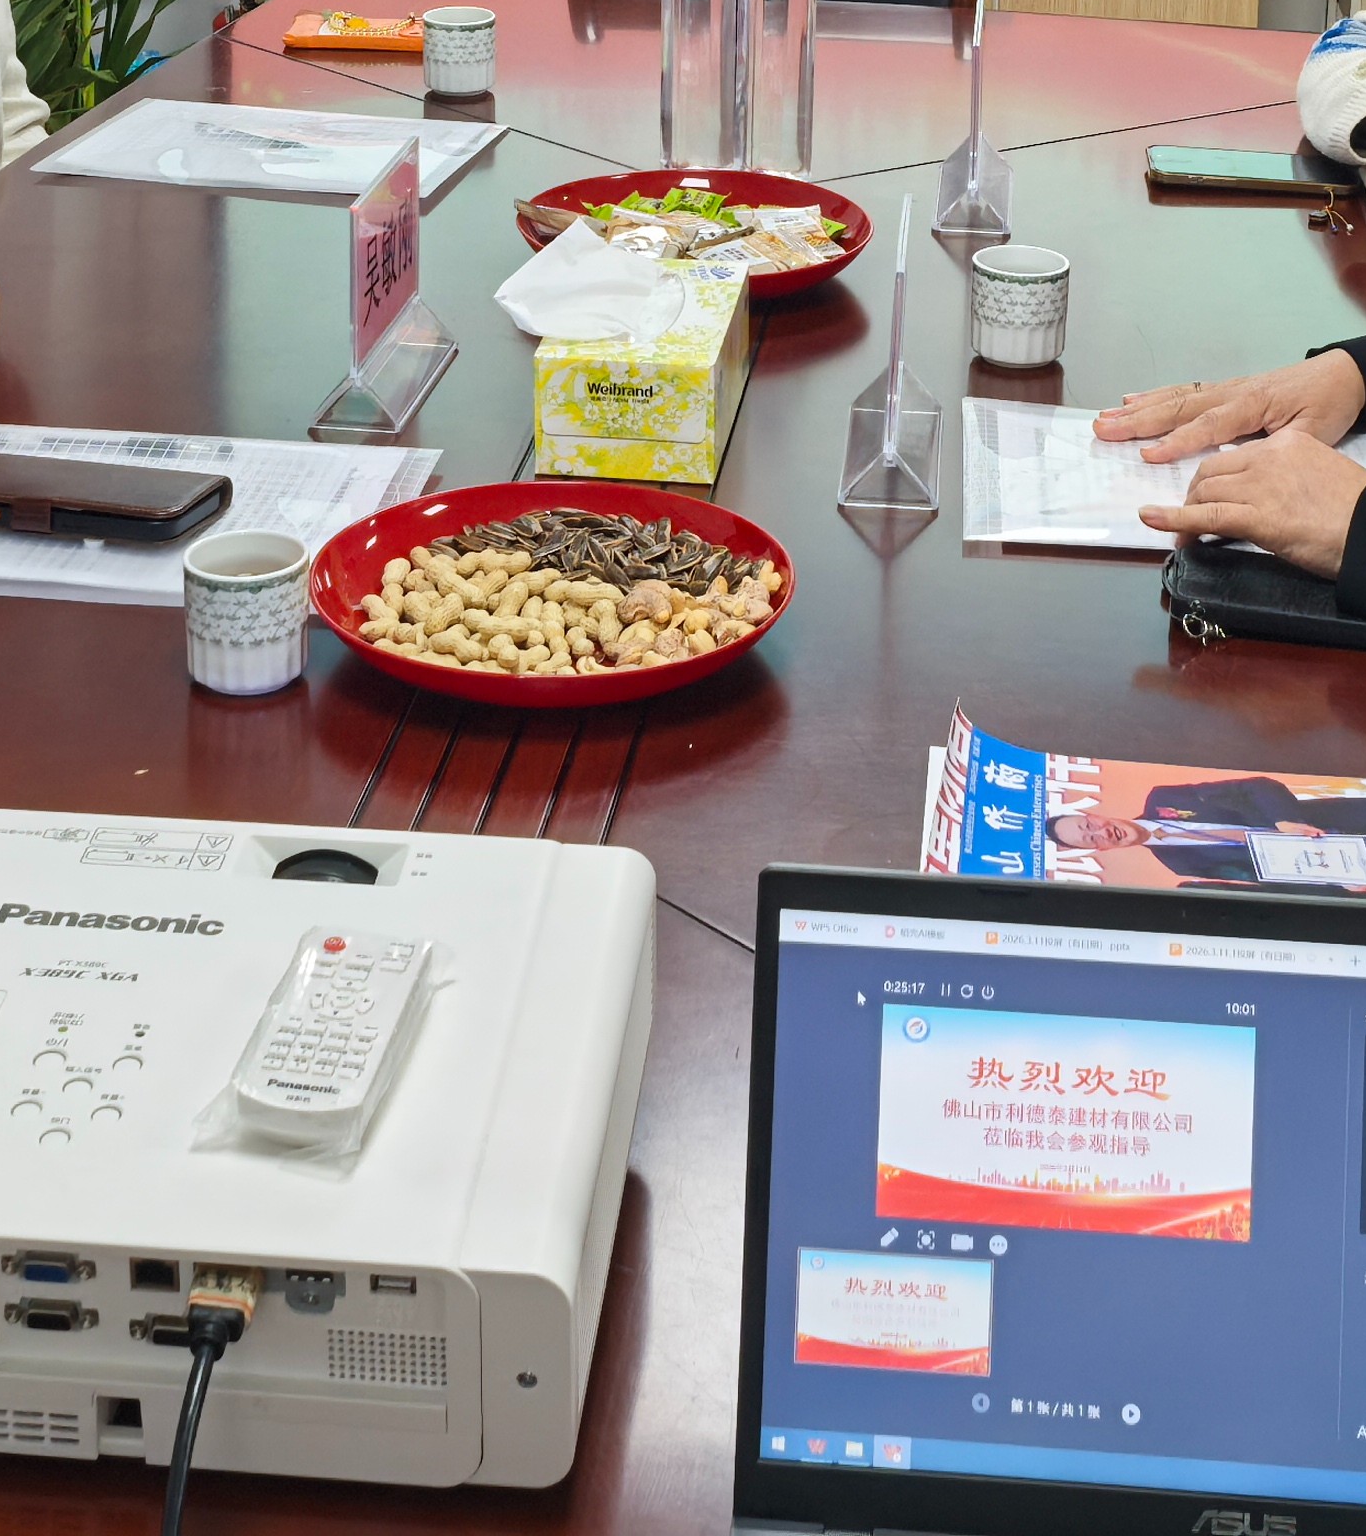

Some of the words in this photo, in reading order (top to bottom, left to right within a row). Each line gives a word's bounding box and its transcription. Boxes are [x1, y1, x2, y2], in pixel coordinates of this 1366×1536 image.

[587, 382, 653, 398] Weibrand
[95, 971, 139, 982] XGA
[883, 980, 925, 995] 0:25:17
[1225, 1002, 1256, 1016] 10:01
[267, 1078, 341, 1095] Panasonic
[966, 1056, 1172, 1101] 热烈欢迎
[941, 1098, 1194, 1134] 佛山市利德泰建材有限公司
[982, 1126, 1152, 1157] 莅临我会参观指导
[845, 1277, 948, 1301] 热烈欢迎
[1191, 1509, 1297, 1536] ASUS
